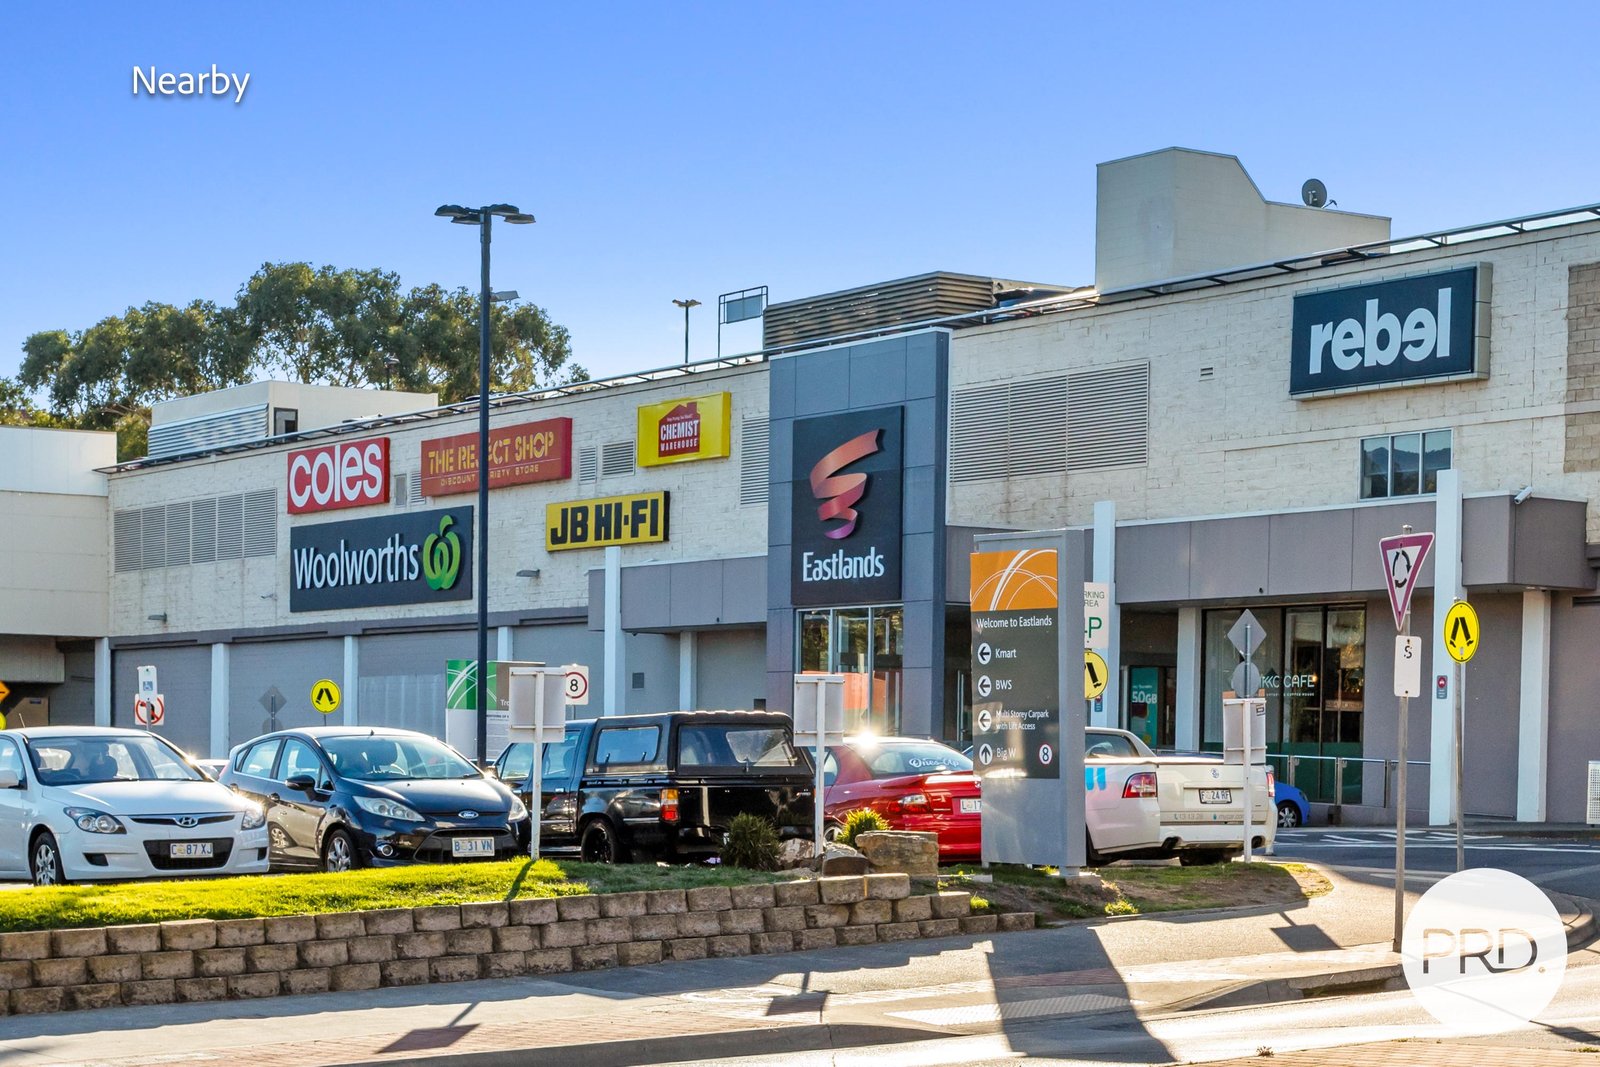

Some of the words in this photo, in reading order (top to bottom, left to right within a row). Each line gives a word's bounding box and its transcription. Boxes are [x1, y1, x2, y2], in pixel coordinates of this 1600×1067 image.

[1309, 287, 1452, 375] rebel
[660, 419, 699, 441] CHEMIST
[660, 438, 698, 452] WAREHOUSE
[428, 448, 454, 475] THE
[458, 436, 512, 471] RECT
[515, 431, 555, 462] SHOP
[289, 443, 383, 508] coles
[440, 473, 476, 487] DISCOUNT
[489, 468, 512, 480] RIETY
[515, 463, 540, 476] STORE
[550, 505, 590, 546] JB
[293, 533, 420, 590] Woolworths
[803, 546, 886, 582] Eastlands
[1084, 590, 1105, 600] RKING
[1084, 600, 1100, 608] REA
[976, 617, 1009, 629] Welcome
[1009, 617, 1018, 628] to
[1019, 615, 1053, 627] Eastlands
[1084, 616, 1103, 639] P
[995, 648, 1017, 659] Kmart
[569, 678, 578, 692] 8
[995, 679, 1013, 690] BWS
[1283, 674, 1315, 688] CAFE
[1131, 690, 1158, 704] 50GB
[1010, 709, 1028, 721] Storey
[1028, 709, 1050, 720] Carpark
[995, 722, 1008, 730] with
[1018, 721, 1036, 730] Access
[996, 747, 1008, 761] Big
[1008, 747, 1017, 758] W
[1042, 746, 1049, 762] 8
[186, 844, 198, 855] 87
[468, 841, 478, 851] 31
